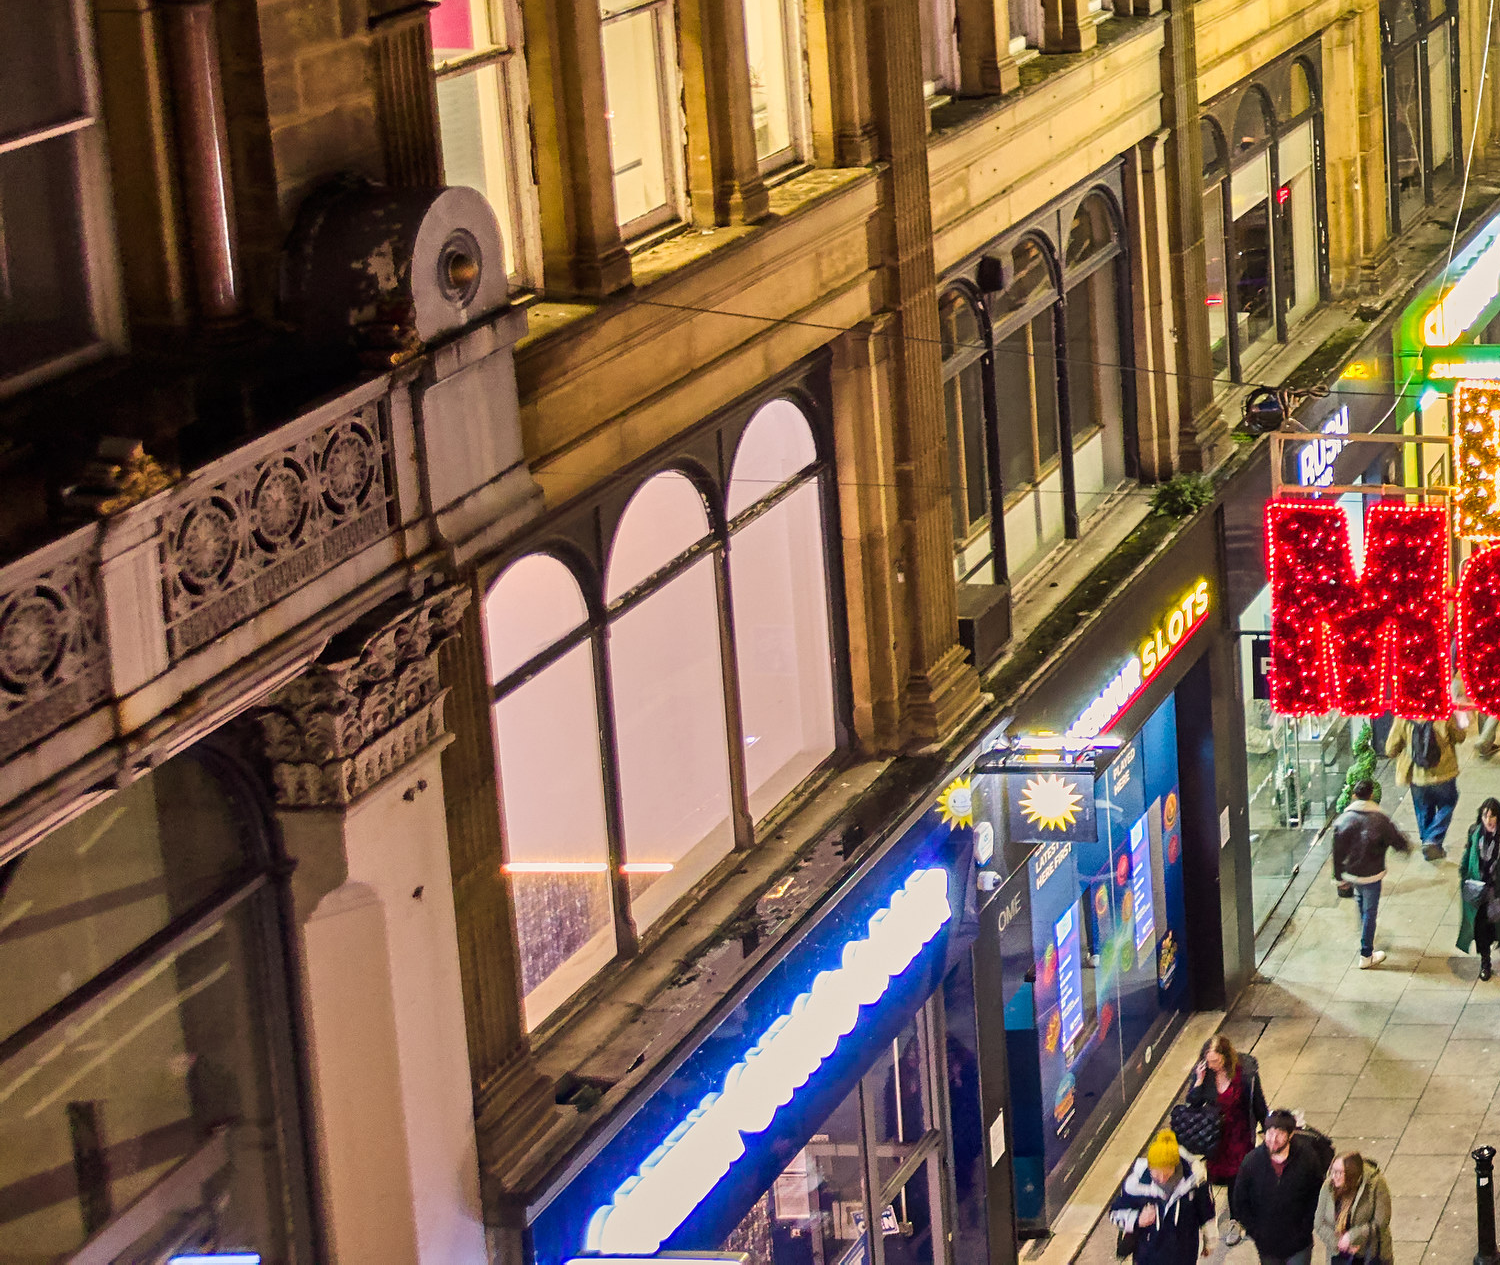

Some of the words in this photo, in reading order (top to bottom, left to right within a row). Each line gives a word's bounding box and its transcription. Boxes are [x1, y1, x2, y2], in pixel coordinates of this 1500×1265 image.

[1142, 581, 1209, 678] SLOTS
[1113, 747, 1136, 781] PLAYED
[1114, 770, 1131, 796] HERE
[1036, 842, 1060, 874] LATEST
[1036, 863, 1055, 890] HERE
